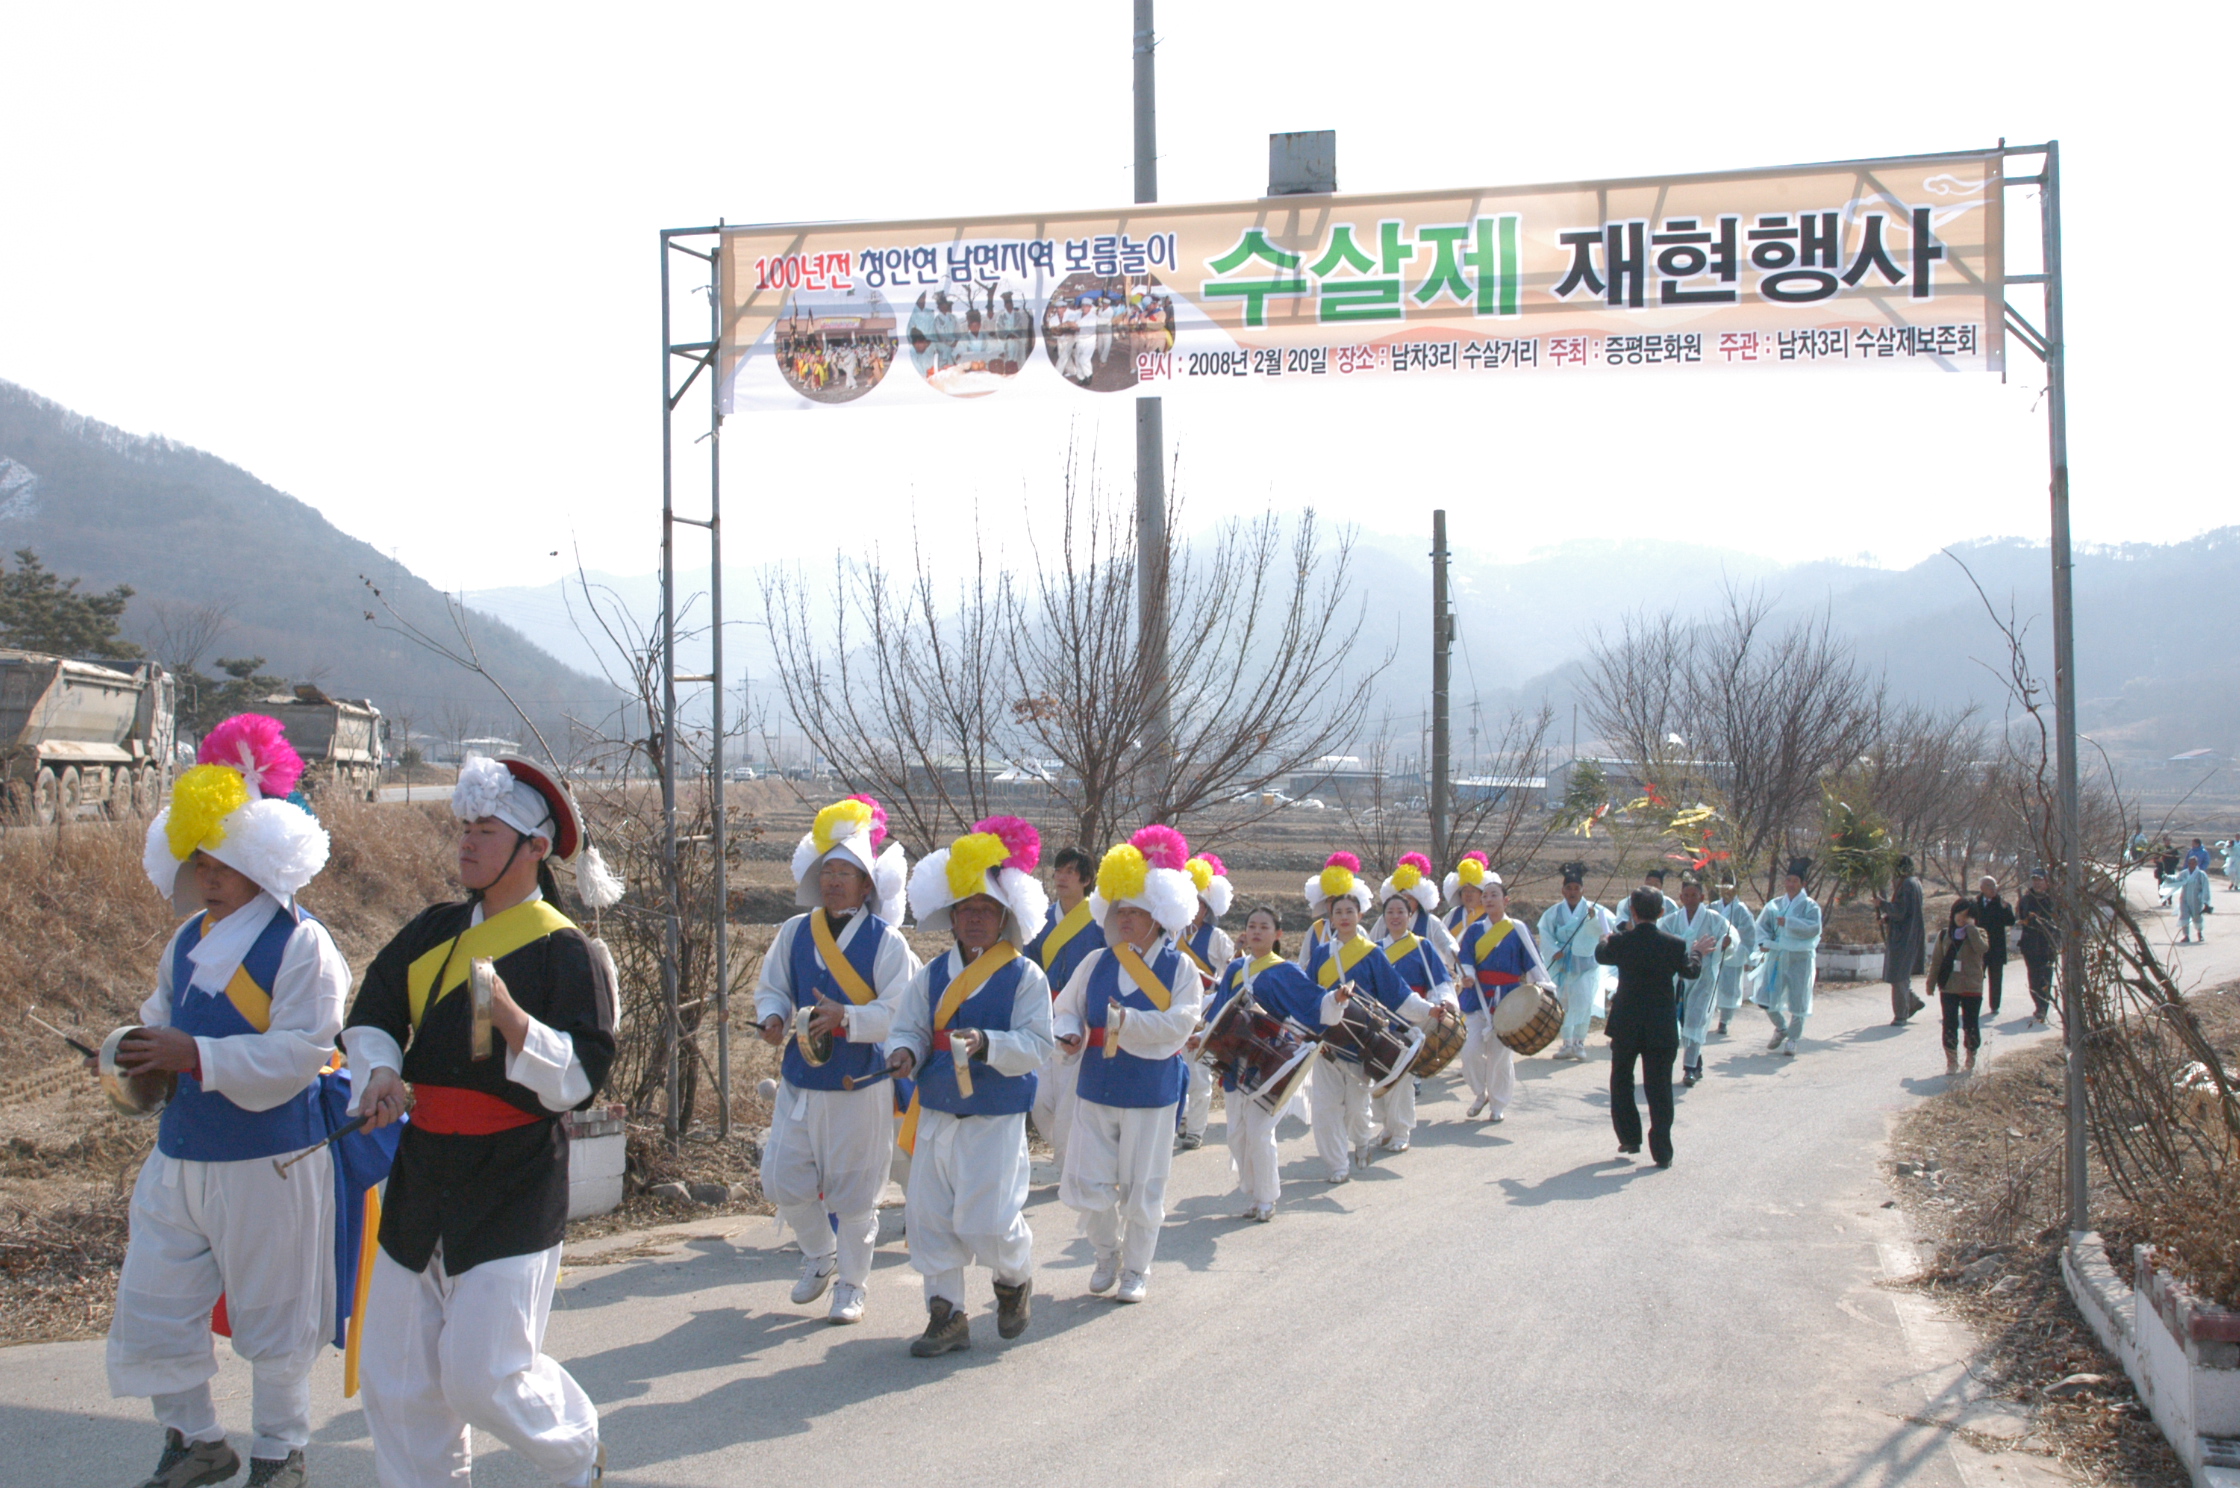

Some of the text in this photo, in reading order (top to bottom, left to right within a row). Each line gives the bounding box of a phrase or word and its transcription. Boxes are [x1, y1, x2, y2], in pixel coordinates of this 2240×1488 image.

[755, 252, 852, 291] 100년전
[946, 240, 1055, 283] 남면지역
[1064, 233, 1176, 275] 보름놀이
[1203, 207, 1943, 327] 수살제 재현행사
[1188, 349, 1248, 376] 2008년
[1253, 348, 1282, 376] 2월
[1287, 346, 1328, 374] 20일
[1391, 340, 1458, 371] 남차3리
[1462, 338, 1538, 369] 수살거리
[1604, 333, 1702, 365] 증평문화원
[1777, 328, 1849, 360] 남차3리
[1854, 324, 1977, 359] 수살제보존회
